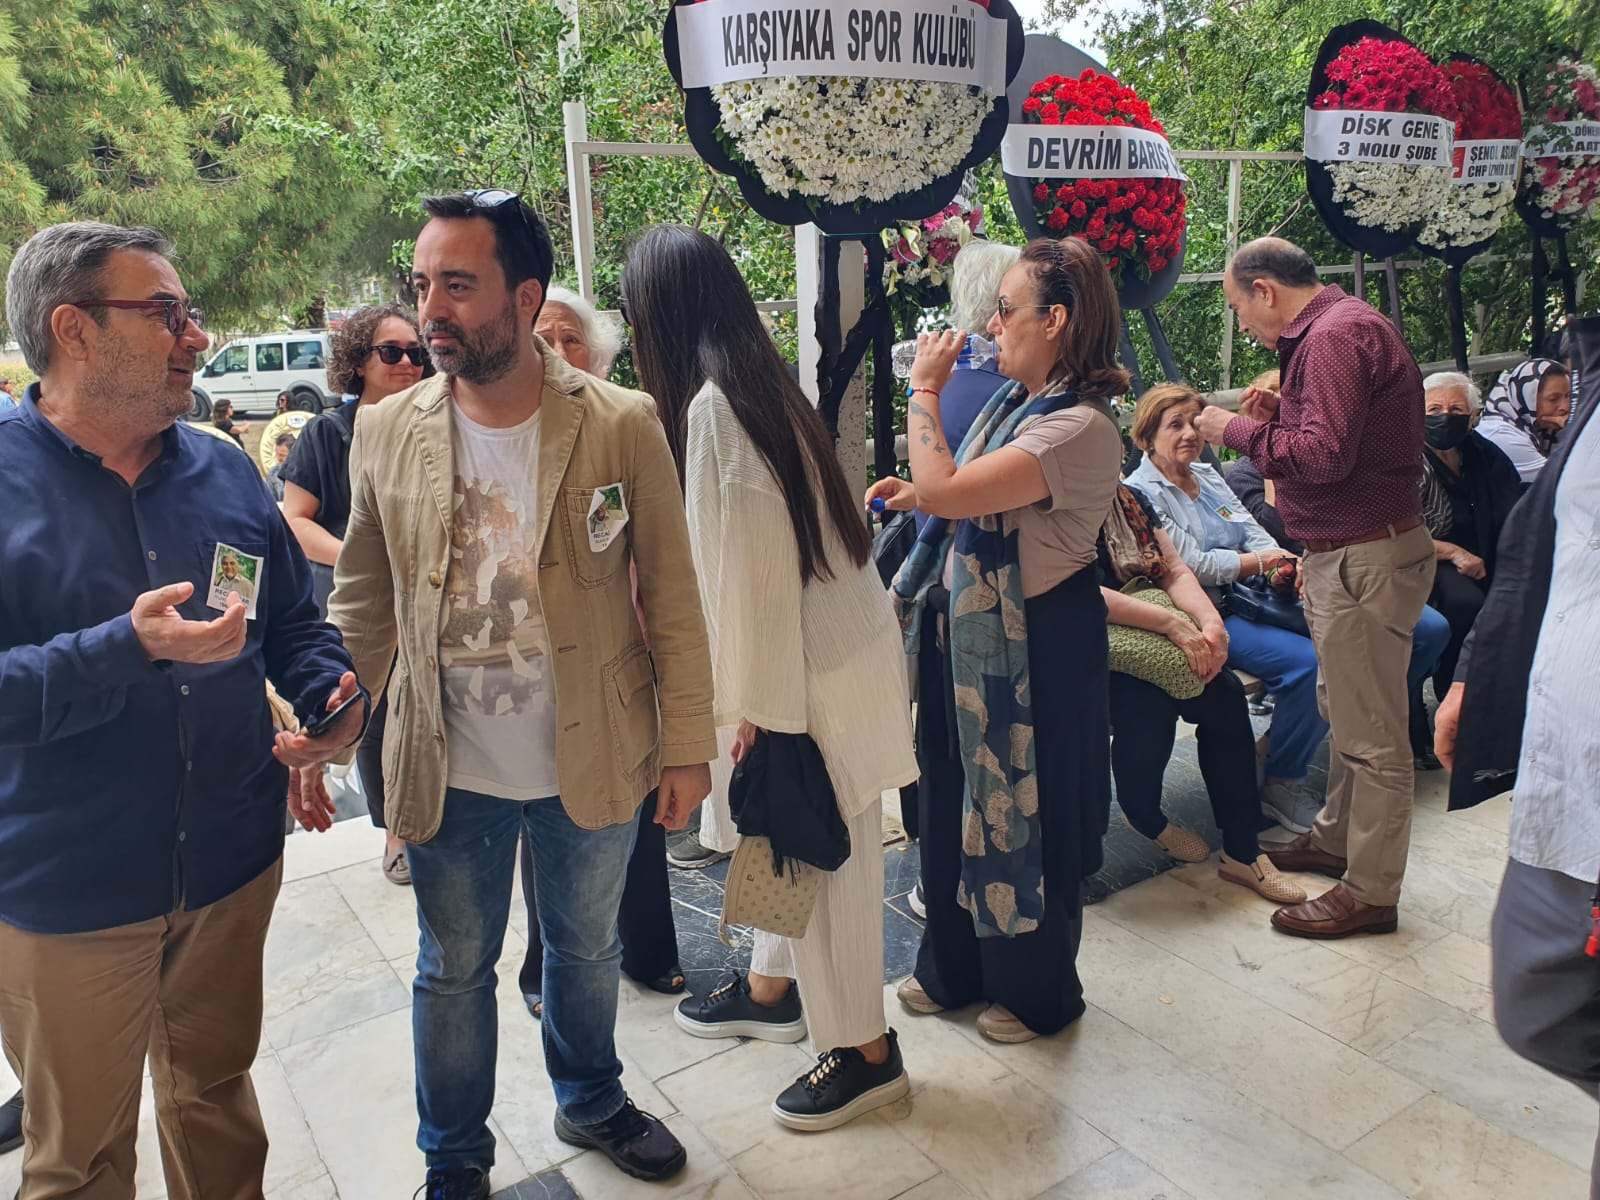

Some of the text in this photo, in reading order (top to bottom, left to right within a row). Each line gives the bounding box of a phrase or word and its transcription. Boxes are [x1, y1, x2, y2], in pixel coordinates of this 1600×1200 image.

[722, 6, 977, 74] KARŞIYAKA SPOR KULÜBÜ
[1341, 113, 1392, 137] DİSK
[1027, 130, 1122, 170] DEVRİM
[1127, 138, 1170, 176] BARIŞ
[1337, 141, 1438, 162] 3 NOLU ŞUBE
[1468, 164, 1488, 177] CHP
